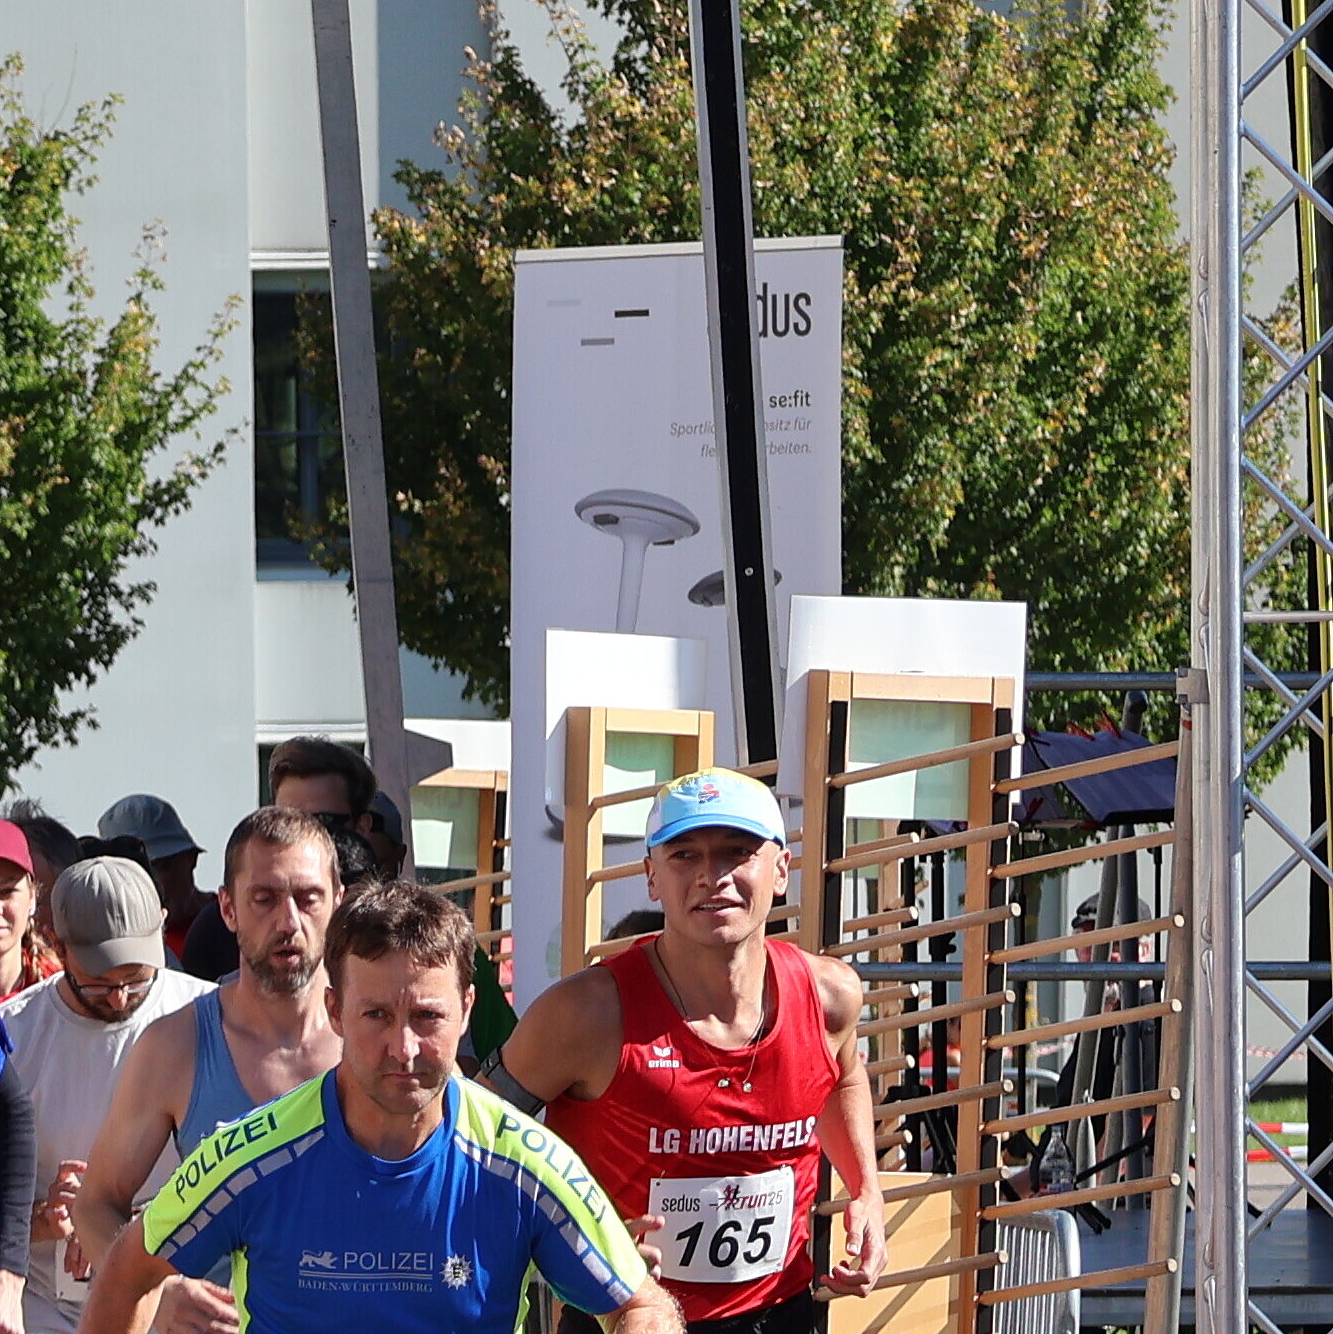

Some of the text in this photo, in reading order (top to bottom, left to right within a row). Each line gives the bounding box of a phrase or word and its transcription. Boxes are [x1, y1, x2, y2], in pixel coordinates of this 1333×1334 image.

[756, 282, 812, 338] dus
[769, 389, 811, 409] se:fit
[670, 421, 717, 438] Sportlic
[793, 417, 811, 432] für
[648, 1115, 817, 1154] LG HOHENFELS
[176, 1112, 278, 1203] POLIZEI
[496, 1113, 607, 1224] POLIZEI
[661, 1194, 700, 1212] sedus
[675, 1216, 776, 1268] 165
[343, 1251, 434, 1271] POLIZEI
[298, 1278, 433, 1293] BADEN-WÜRTTEMBERG
